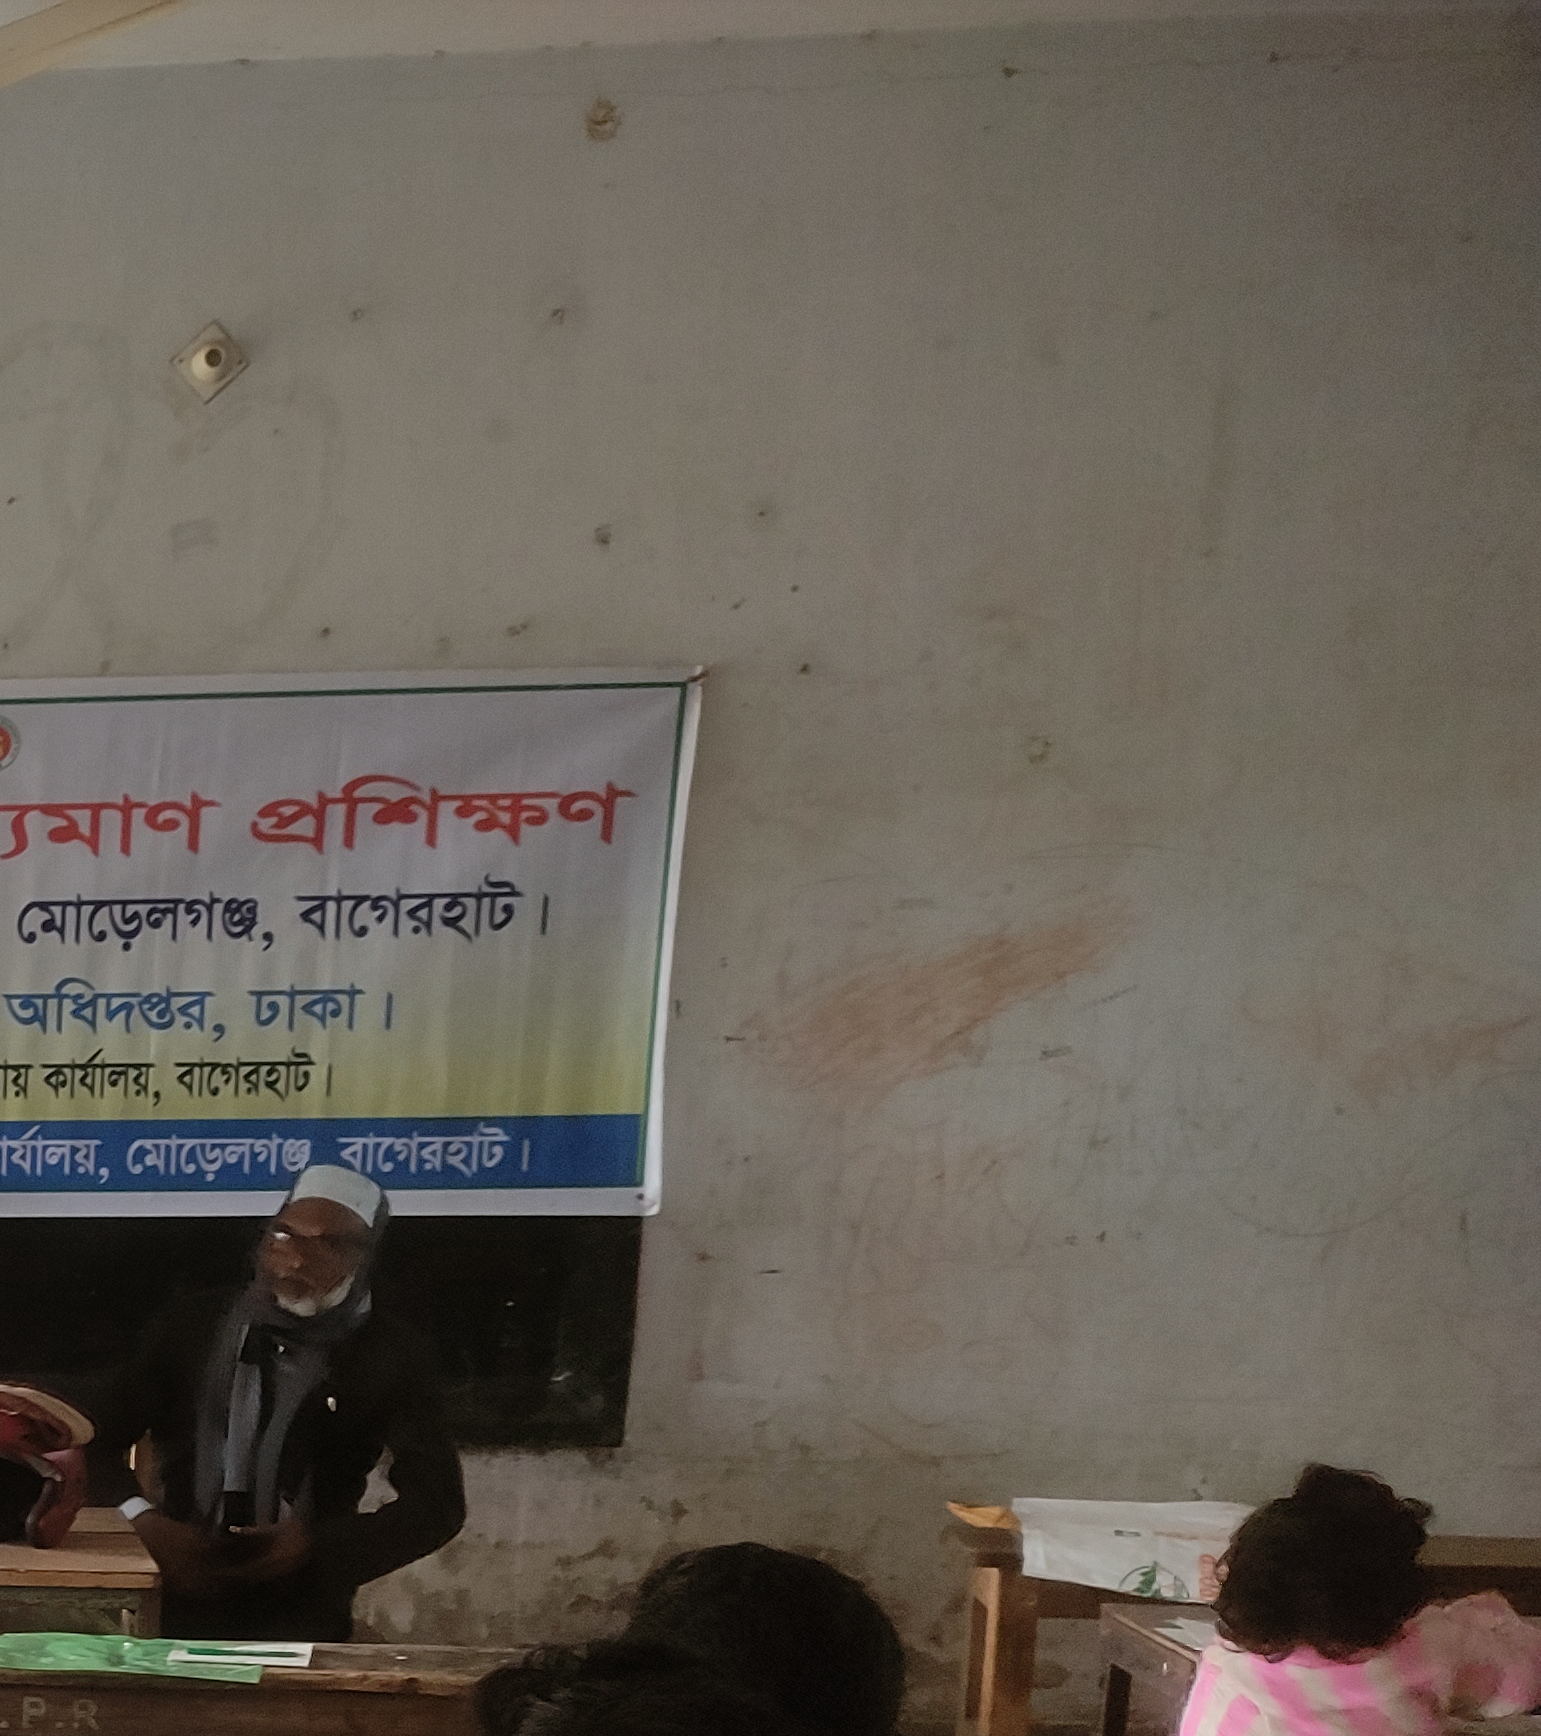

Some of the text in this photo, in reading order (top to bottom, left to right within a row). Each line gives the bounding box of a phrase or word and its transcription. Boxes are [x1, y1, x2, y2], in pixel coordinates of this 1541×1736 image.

[249, 774, 636, 856] প্রশিক্ষণ
[16, 893, 274, 952] মোড়েলগঞ্জ,
[2, 976, 226, 1042] অধিদপ্তর,
[40, 1047, 163, 1107] কার্যালয়,
